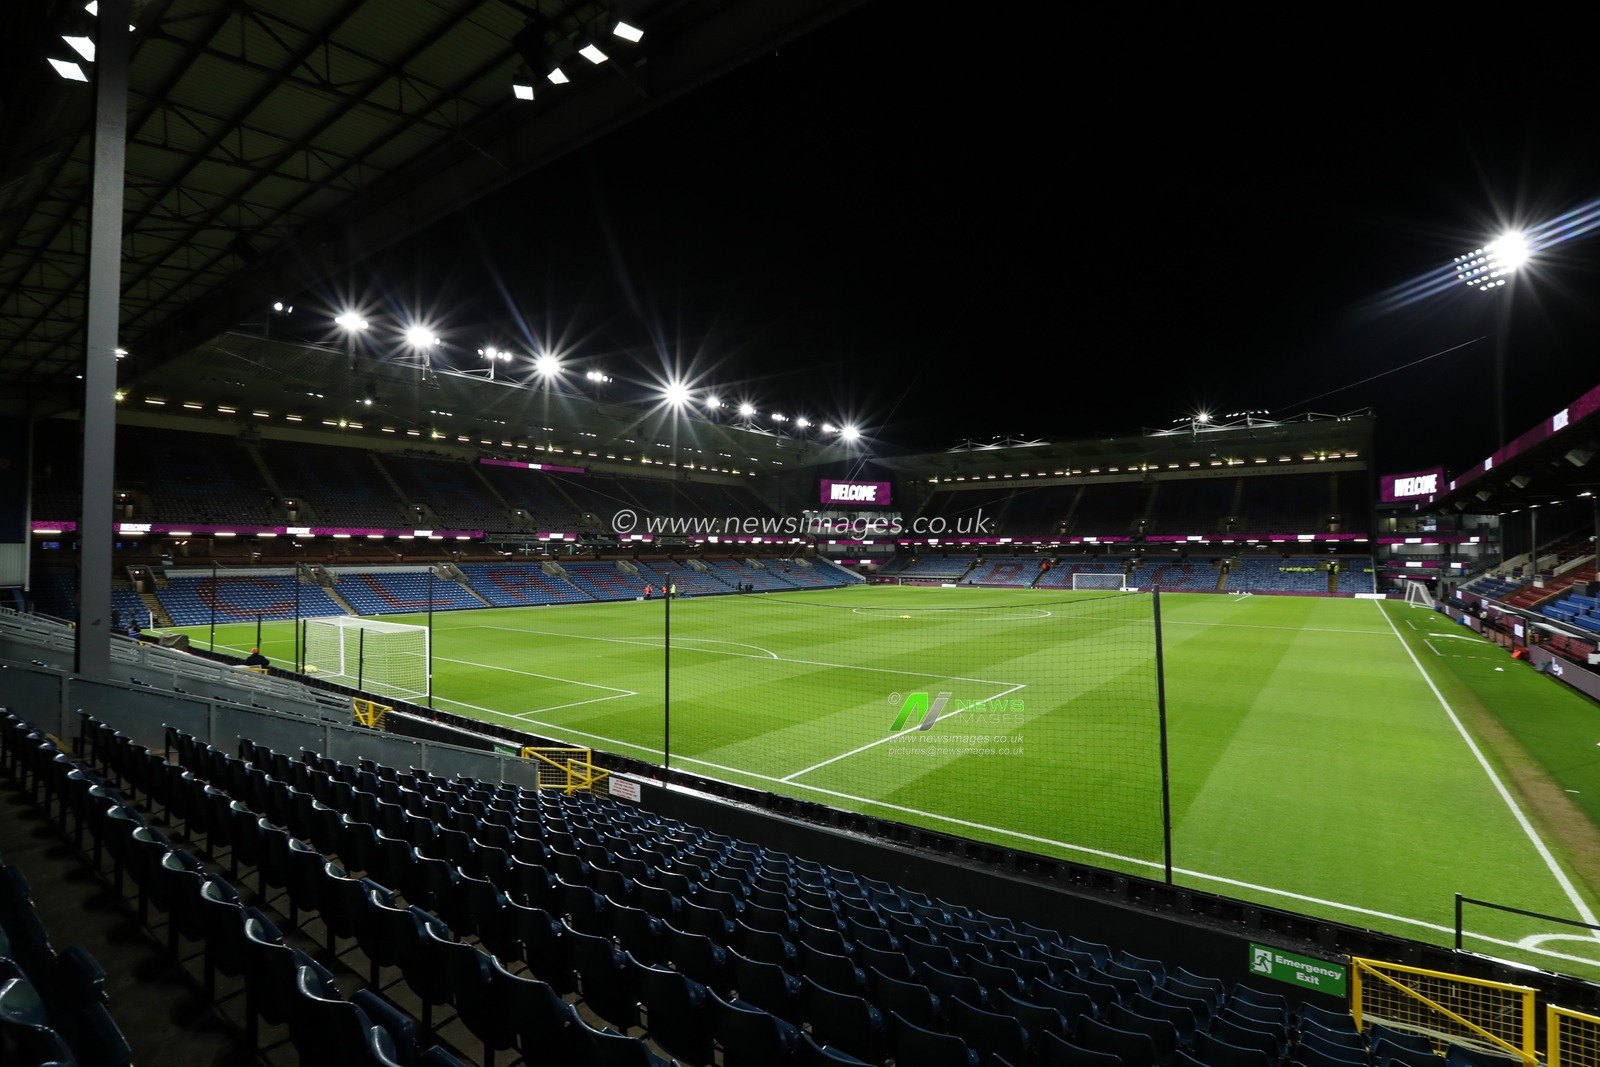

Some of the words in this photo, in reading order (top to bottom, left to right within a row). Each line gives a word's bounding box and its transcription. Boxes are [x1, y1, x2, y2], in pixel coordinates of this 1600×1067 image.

[830, 484, 877, 501] WELCOME
[1394, 474, 1438, 497] WELCOME
[1275, 955, 1342, 980] Emergency
[1296, 971, 1320, 985] Exit
